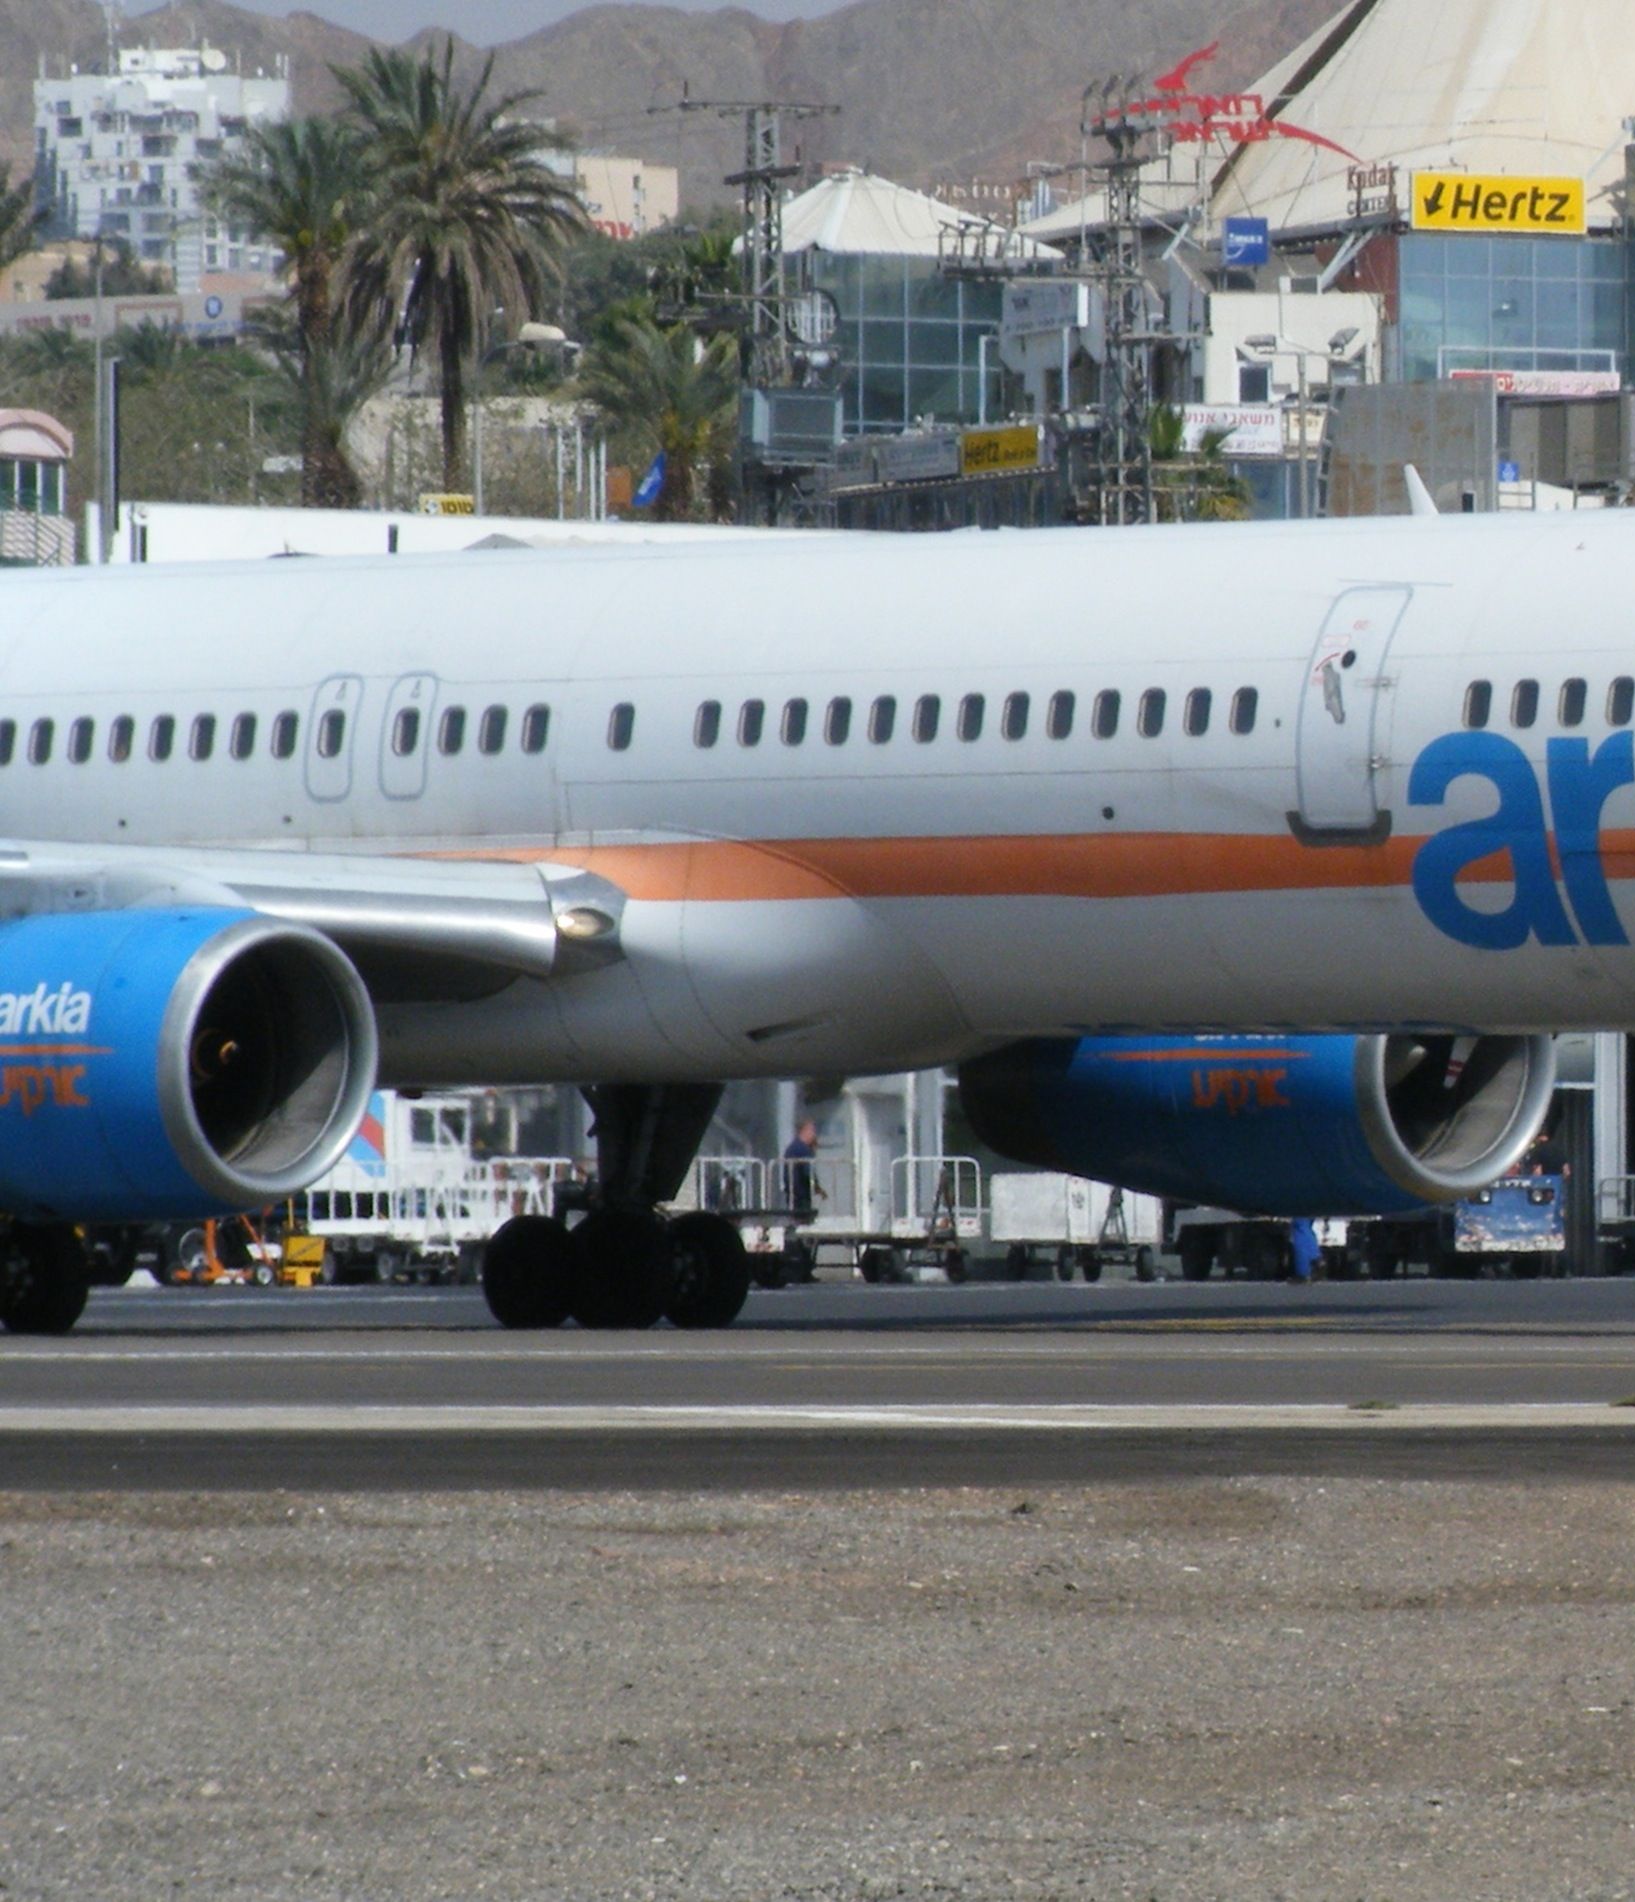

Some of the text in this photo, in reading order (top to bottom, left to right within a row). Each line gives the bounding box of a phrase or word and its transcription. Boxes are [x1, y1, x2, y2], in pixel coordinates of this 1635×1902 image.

[1347, 194, 1395, 215] CNTE
[1451, 183, 1570, 221] Hertz
[0, 981, 91, 1034] arkia
